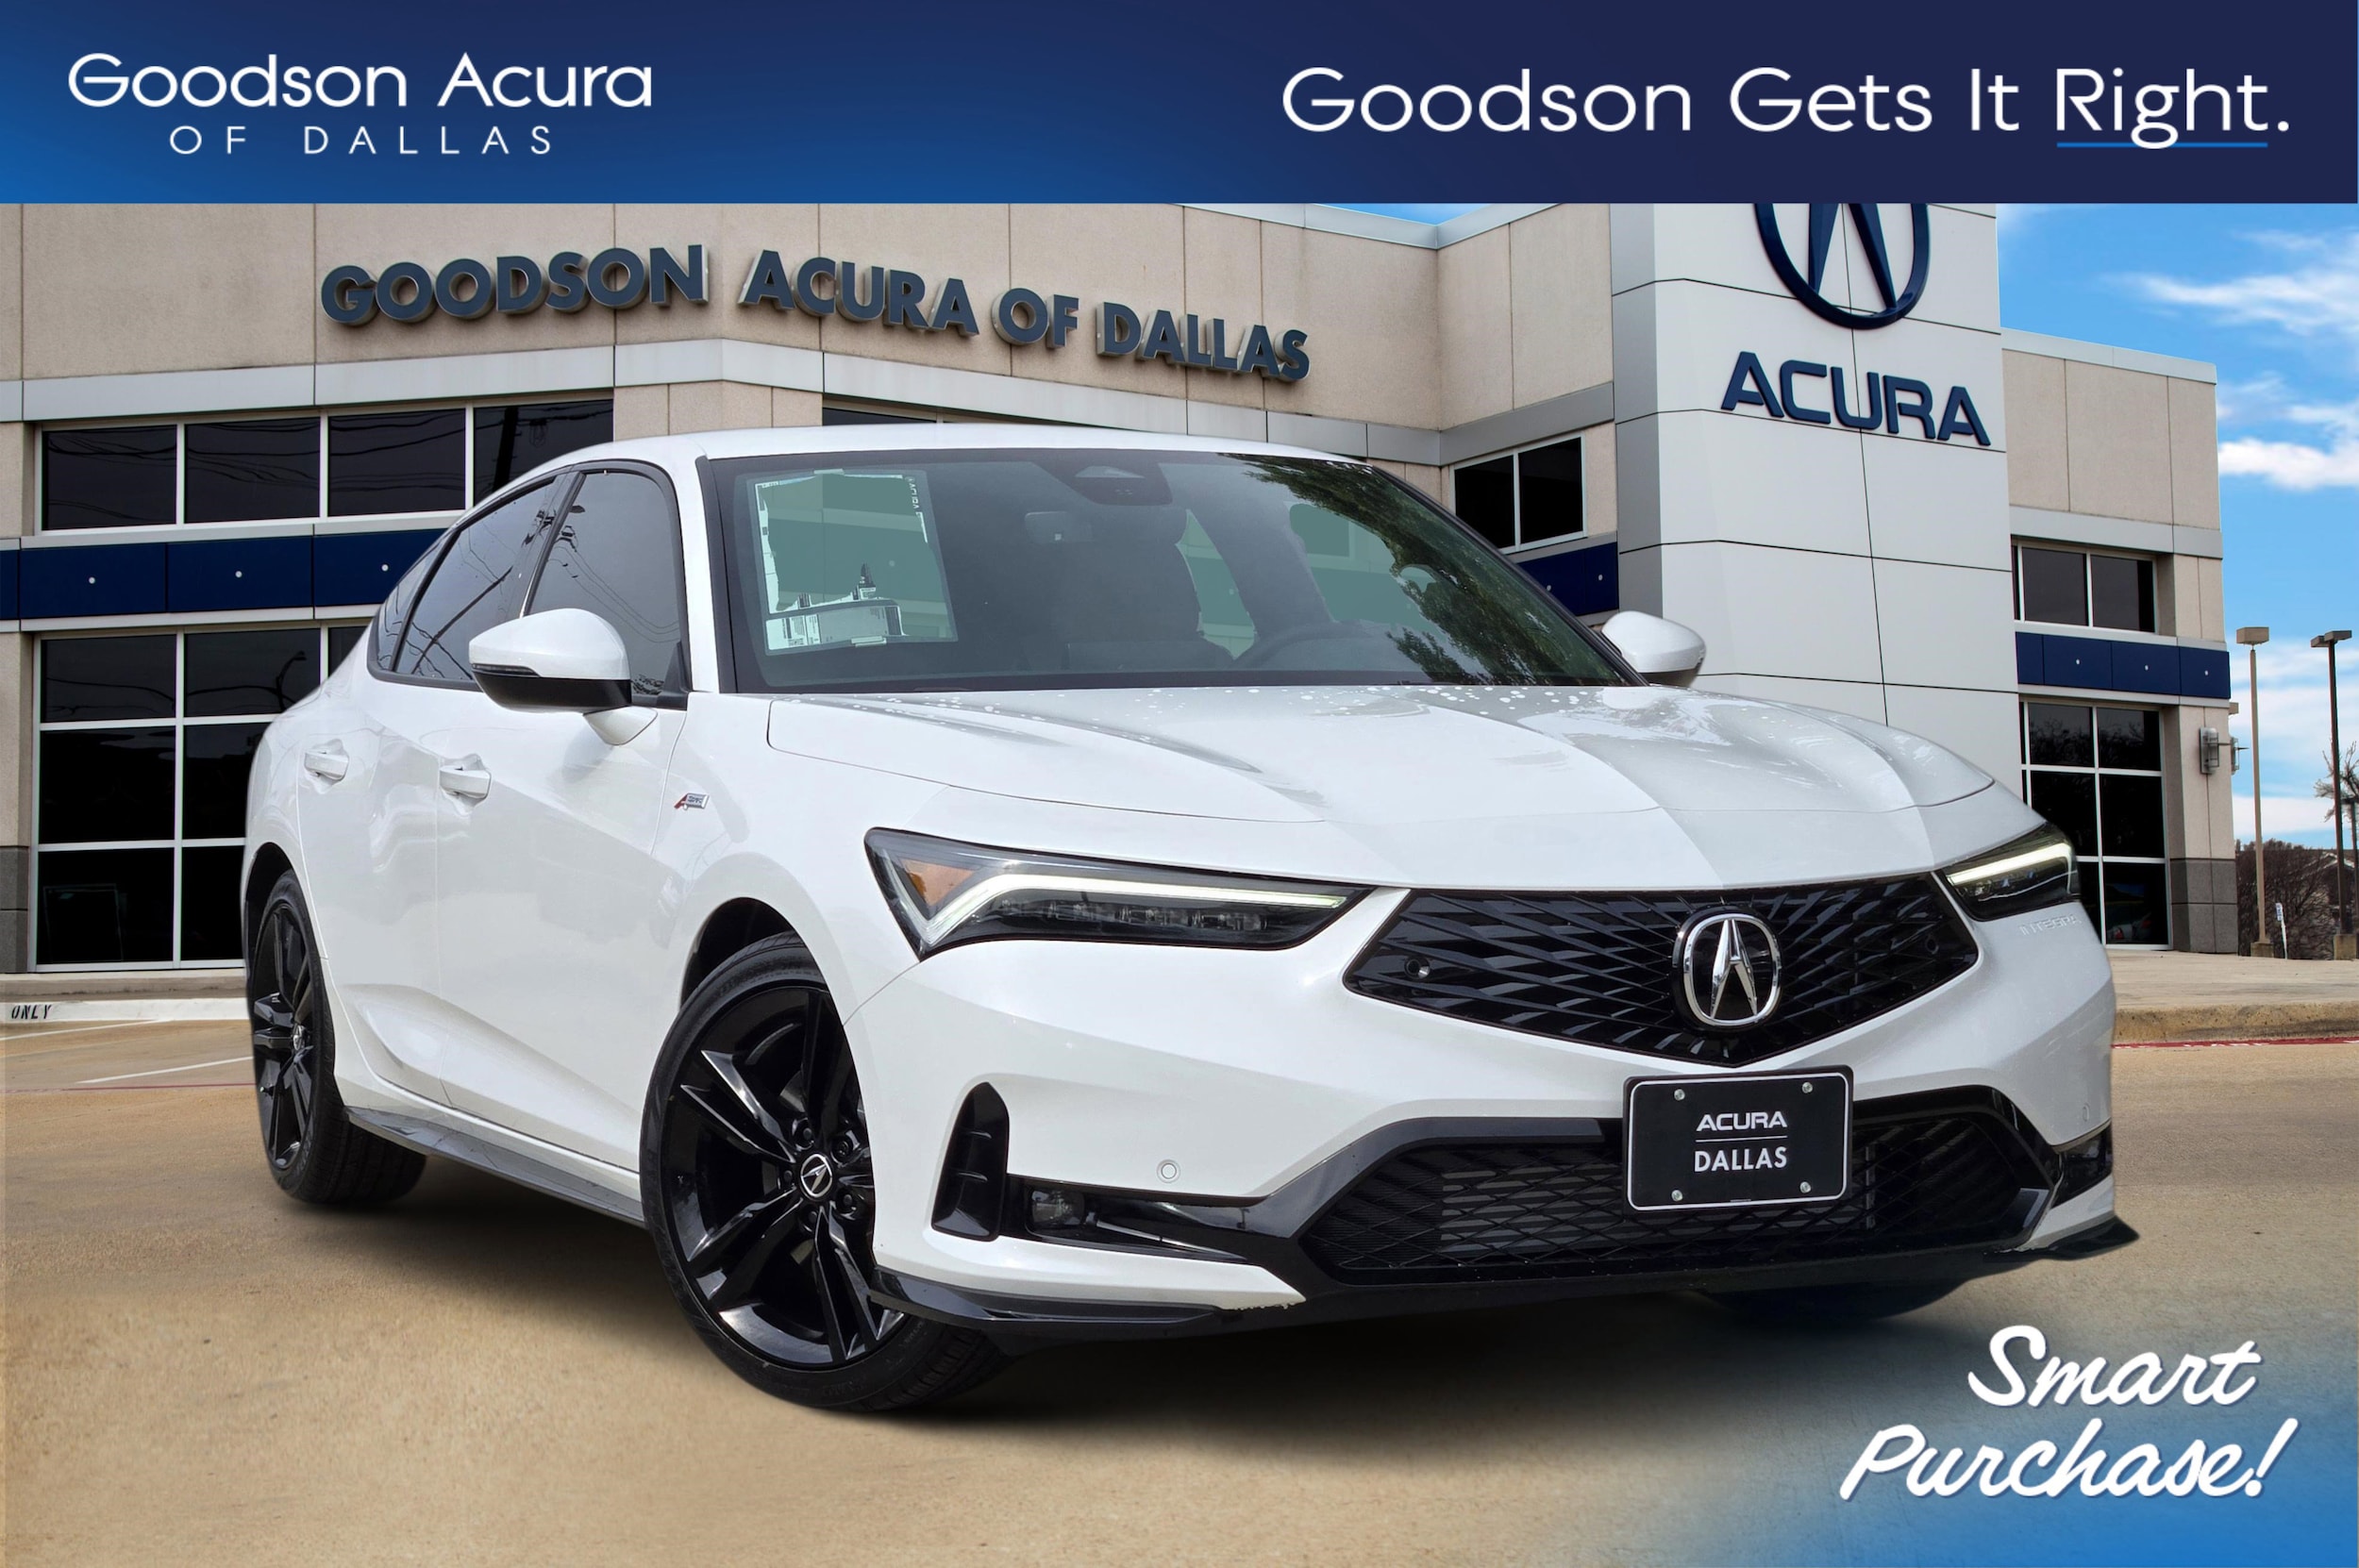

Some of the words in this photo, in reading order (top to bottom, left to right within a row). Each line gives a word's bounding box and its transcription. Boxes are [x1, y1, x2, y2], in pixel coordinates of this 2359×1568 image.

[321, 244, 708, 326] GOODSON
[738, 249, 979, 337] ACURA
[992, 287, 1079, 349] OF
[1096, 301, 1310, 382] DALLAS
[1721, 351, 1992, 446] ACURA
[11, 1004, 52, 1020] ONLY
[1696, 1110, 1788, 1132] ACURA
[1694, 1146, 1788, 1173] DALLAS
